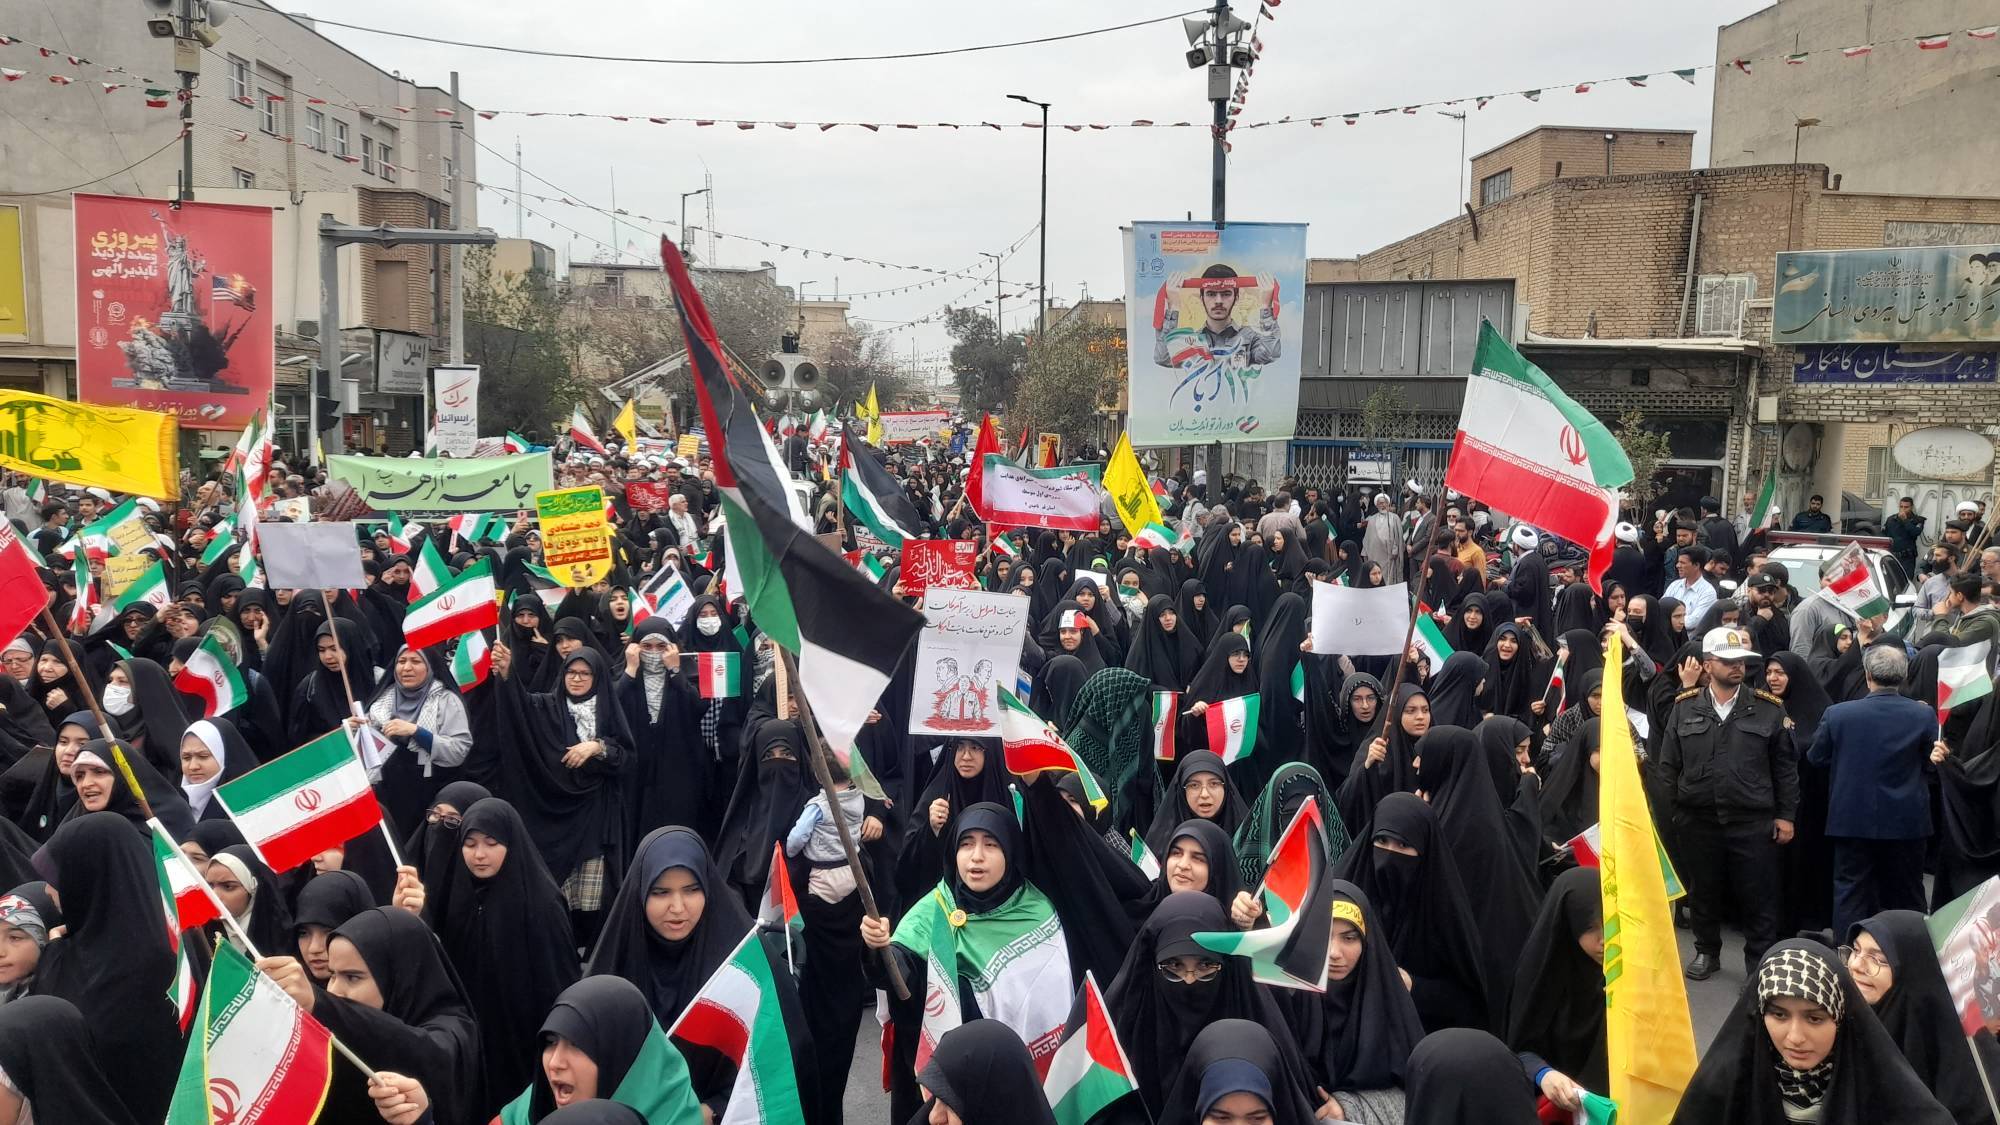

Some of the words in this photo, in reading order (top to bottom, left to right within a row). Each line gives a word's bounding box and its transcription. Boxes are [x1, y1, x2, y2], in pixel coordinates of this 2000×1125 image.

[91, 228, 159, 250] پیروزی
[91, 262, 122, 278] الهی
[127, 252, 158, 265] وعده
[1781, 292, 1851, 335] انسانی
[1853, 292, 1898, 323] نیروی
[1898, 291, 1968, 324] آموزش
[1800, 345, 1862, 372] کامکار
[1854, 345, 1989, 380] دبیرستان
